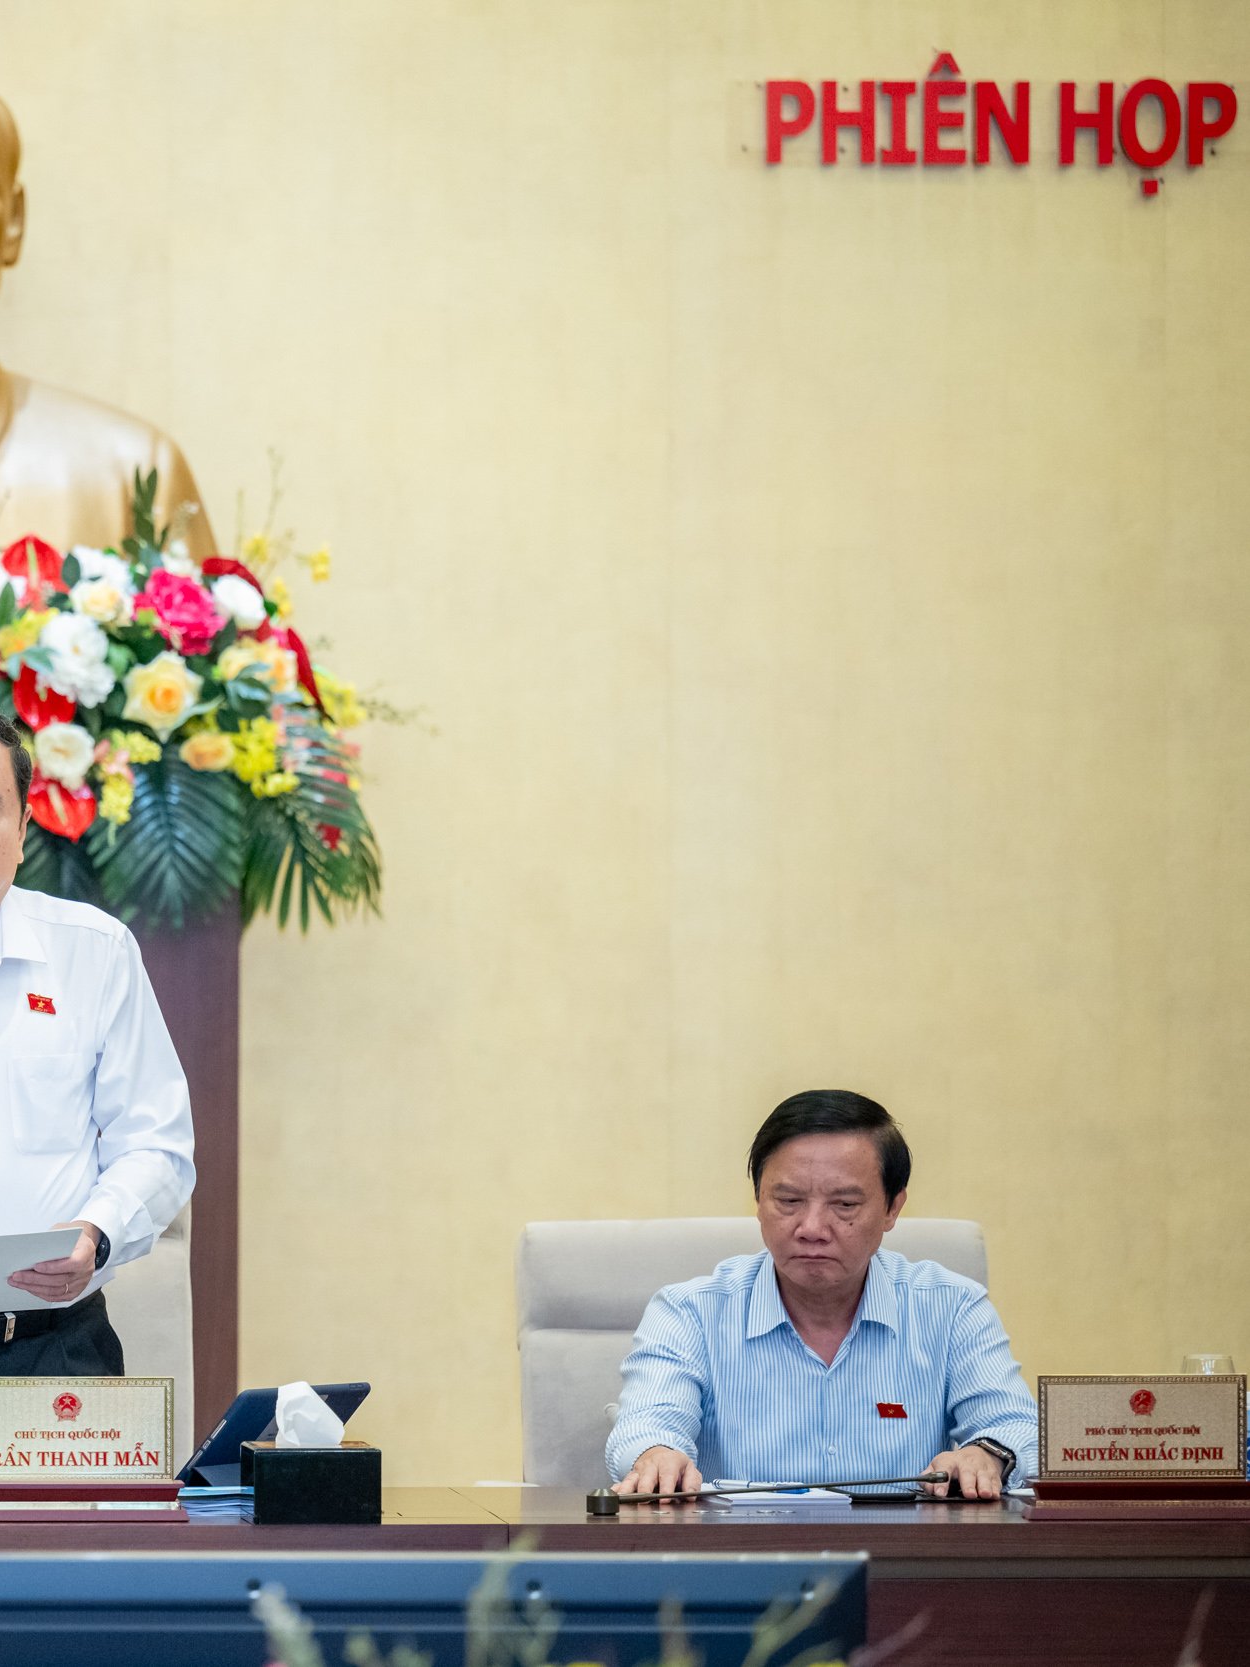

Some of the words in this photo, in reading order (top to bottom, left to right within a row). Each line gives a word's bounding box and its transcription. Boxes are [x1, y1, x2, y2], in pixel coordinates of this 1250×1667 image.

[765, 51, 1030, 165] PHIÊN
[1058, 78, 1237, 197] HỌP
[14, 1428, 37, 1439] CHỦ
[40, 1430, 65, 1441] TỊCH
[68, 1428, 99, 1440] QUỐC
[101, 1428, 121, 1441] HỘI
[37, 1451, 108, 1467] THANH
[113, 1441, 160, 1467] MẪN
[1061, 1441, 1129, 1462] NGUYỄN
[1133, 1441, 1178, 1461] KHẮC
[1181, 1446, 1224, 1464] ĐỊNH
